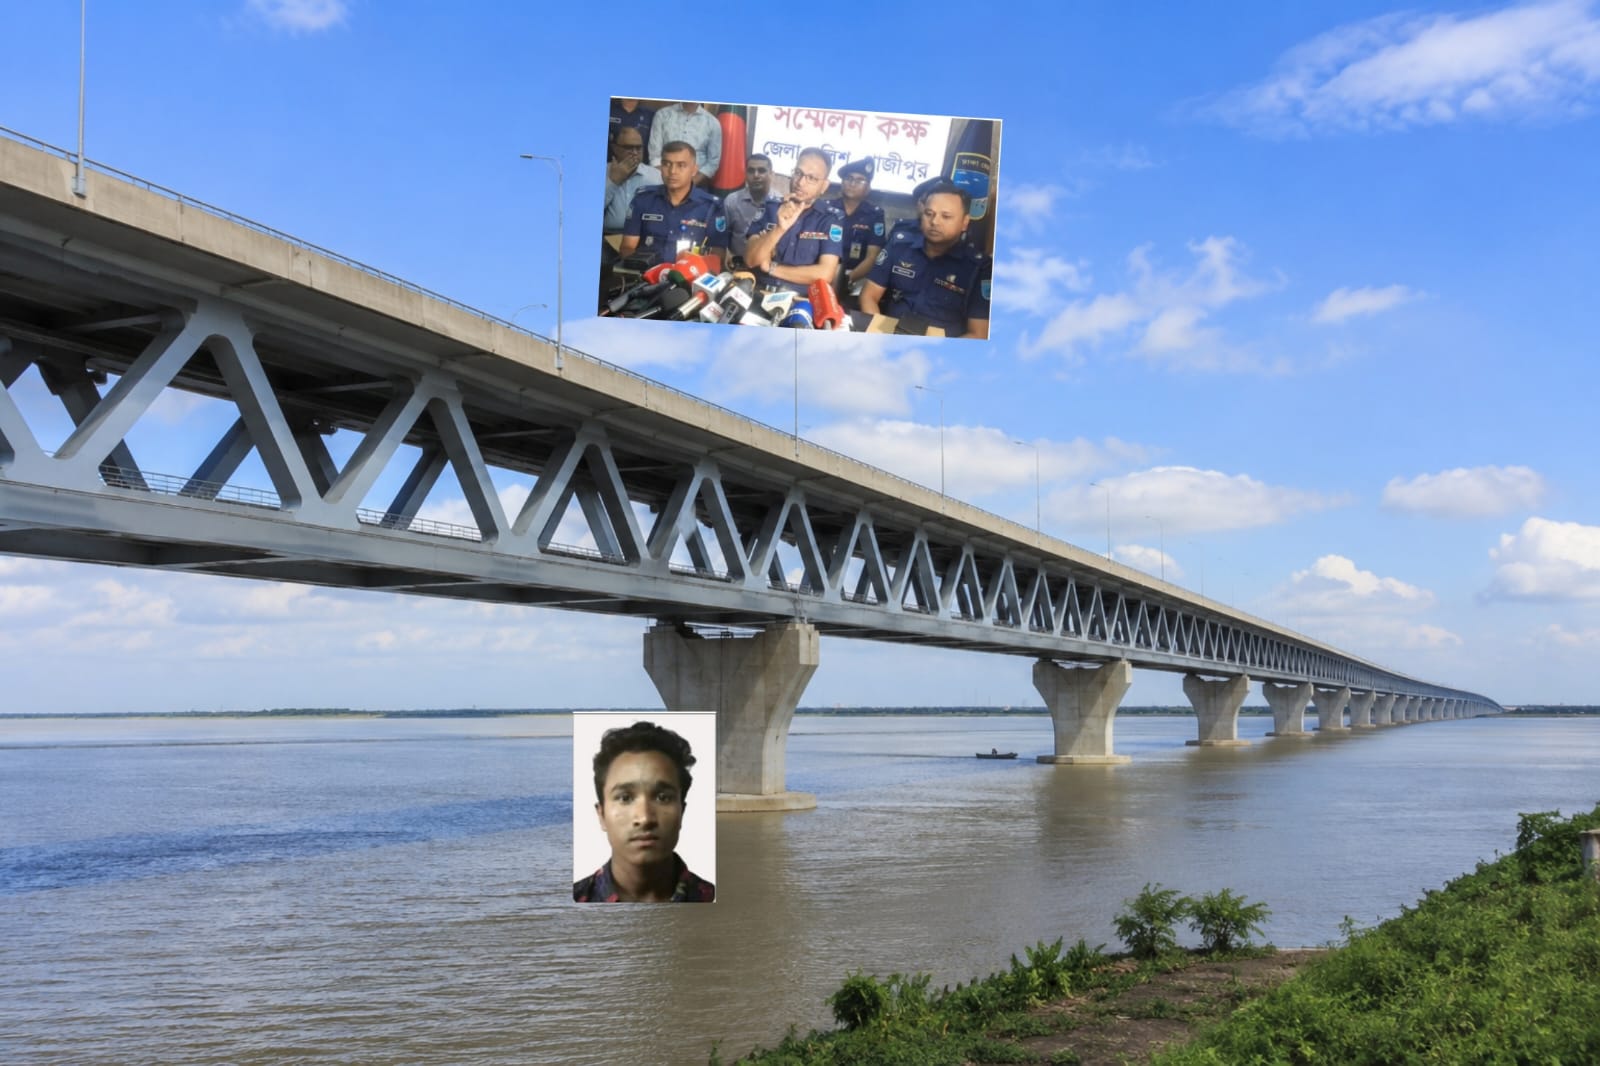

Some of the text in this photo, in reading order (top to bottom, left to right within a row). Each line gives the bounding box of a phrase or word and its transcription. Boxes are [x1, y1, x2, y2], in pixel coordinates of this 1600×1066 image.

[774, 106, 930, 145] সম্মেলন কক্ষ
[763, 141, 802, 160] জেলা
[873, 151, 930, 182] াজীপুর
